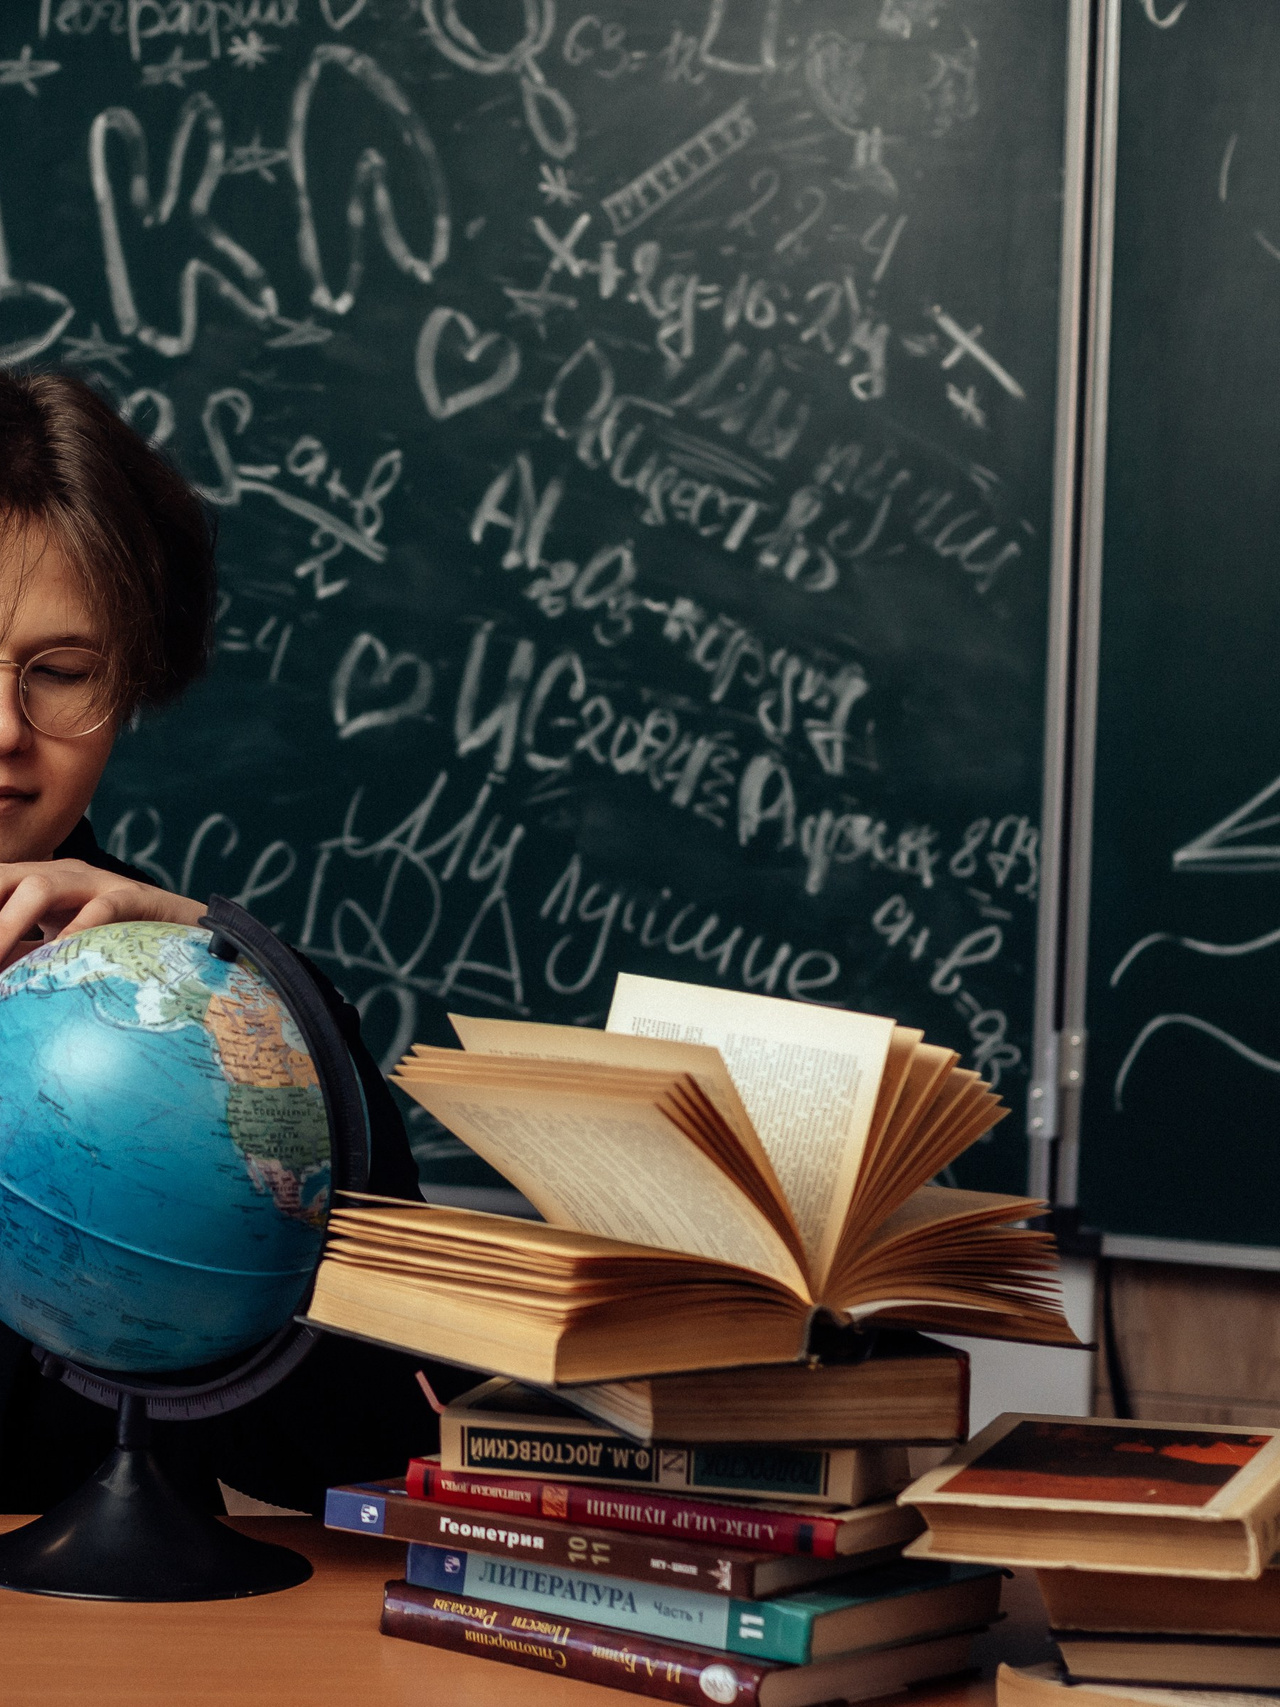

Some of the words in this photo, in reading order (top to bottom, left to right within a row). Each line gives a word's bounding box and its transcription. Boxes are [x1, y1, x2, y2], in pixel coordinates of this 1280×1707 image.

[470, 1435, 603, 1467] ДОСТОЕВСКИЙ
[607, 1446, 650, 1470] Ф.М.
[586, 1498, 666, 1525] ПУШКИН
[671, 1511, 779, 1541] АЛЕКСАНДР
[438, 1516, 545, 1550] Геометрия
[478, 1560, 639, 1614] ЛИТЕРАТУРА
[432, 1597, 498, 1630] Рассказы
[653, 1600, 693, 1622] Часть
[510, 1615, 572, 1646] Повести
[464, 1628, 567, 1669] Стихотворения
